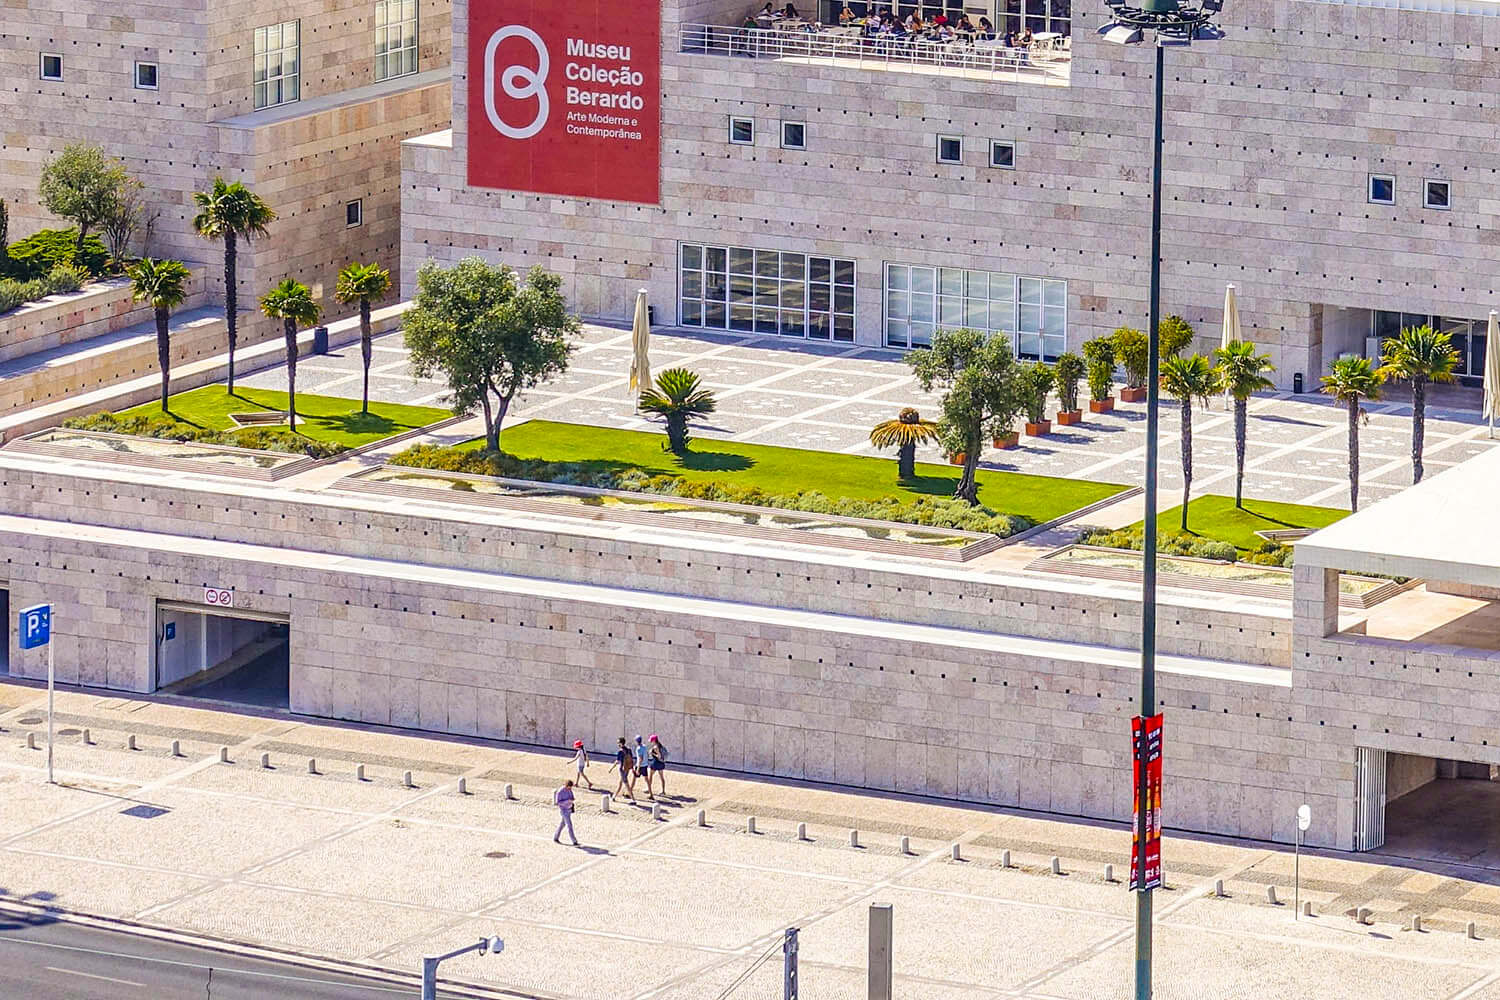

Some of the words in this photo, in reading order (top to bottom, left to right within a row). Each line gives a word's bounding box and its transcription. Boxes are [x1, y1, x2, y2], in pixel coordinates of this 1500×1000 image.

[566, 38, 631, 61] Museu
[565, 62, 644, 87] Coleção
[566, 86, 644, 110] Berardo
[567, 111, 587, 122] Arte
[588, 113, 630, 126] Moderna
[631, 118, 638, 126] e
[566, 124, 642, 140] Contemporânea
[27, 614, 40, 638] P
